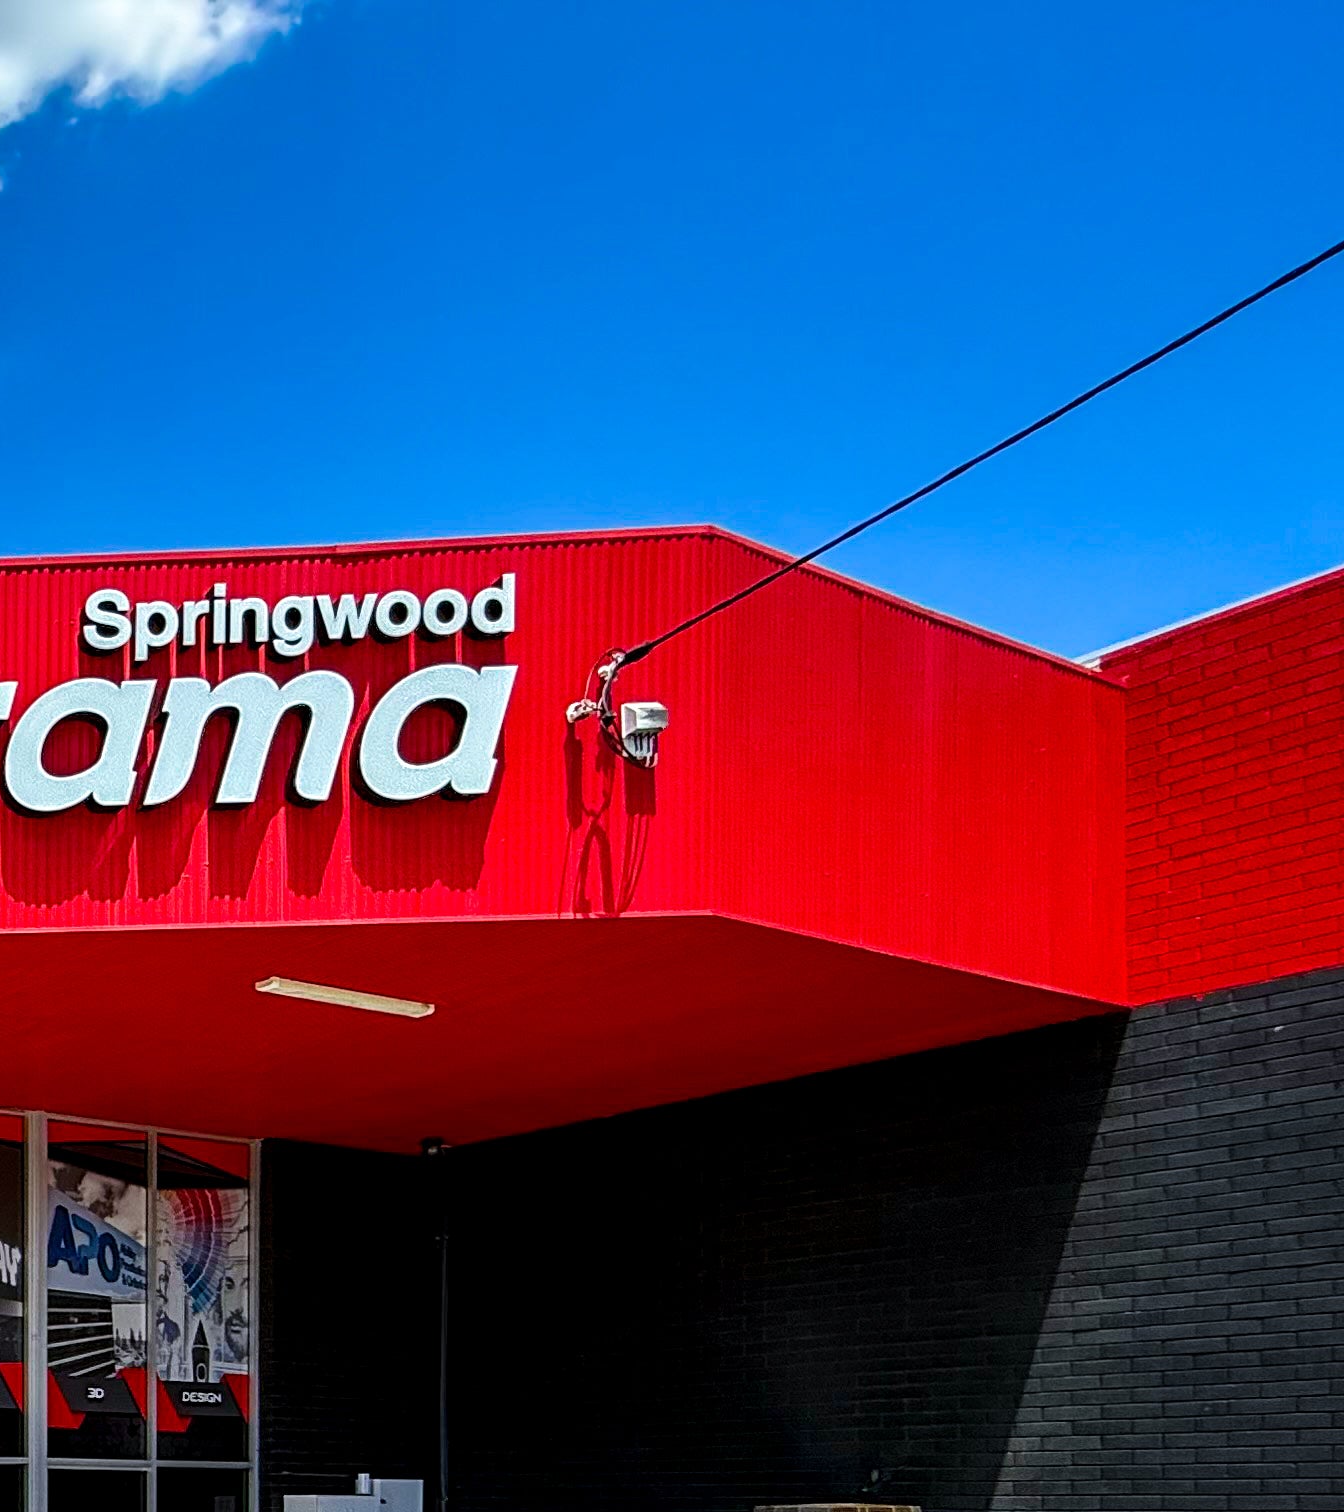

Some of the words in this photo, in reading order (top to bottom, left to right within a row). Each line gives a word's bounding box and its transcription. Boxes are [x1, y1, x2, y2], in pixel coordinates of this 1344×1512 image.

[82, 573, 516, 662] Springwood
[88, 1388, 104, 1398] 3D
[183, 1392, 221, 1402] DESIGN
